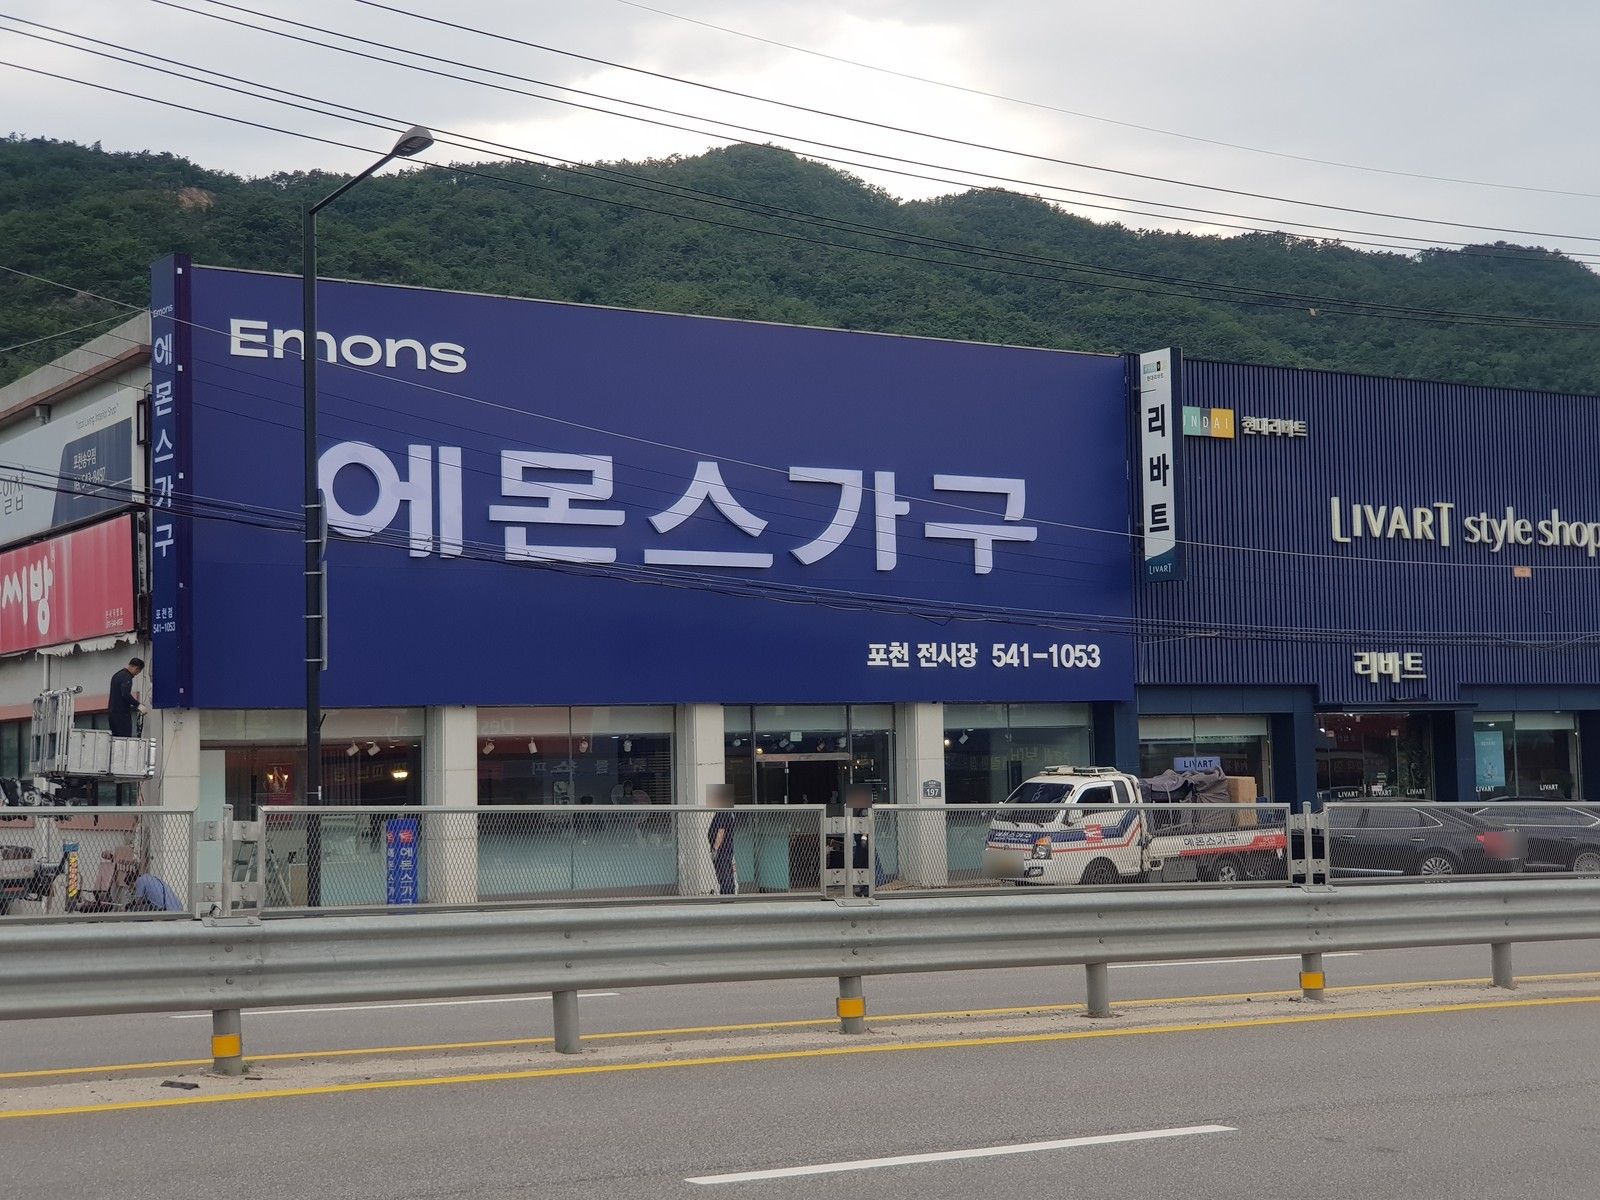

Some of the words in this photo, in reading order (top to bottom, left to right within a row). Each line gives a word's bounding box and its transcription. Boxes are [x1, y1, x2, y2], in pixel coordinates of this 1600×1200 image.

[230, 318, 468, 374] Emons
[1241, 415, 1308, 437] 현대리바트
[154, 333, 174, 557] 에몬스가구
[1147, 403, 1170, 533] 리바트
[317, 440, 1039, 575] 에몬스가구
[1331, 496, 1454, 547] LIVART
[1464, 506, 1533, 552] style
[1149, 563, 1172, 575] LIVART
[0, 555, 53, 636] 씨방
[867, 641, 910, 668] 포천
[917, 642, 978, 668] 전시장
[991, 642, 1101, 669] 541-1053
[1353, 651, 1427, 683] 리바트
[1183, 759, 1214, 769] LIVART
[926, 788, 939, 797] 197
[1338, 790, 1359, 798] LIVART
[1539, 783, 1559, 791] LIVART
